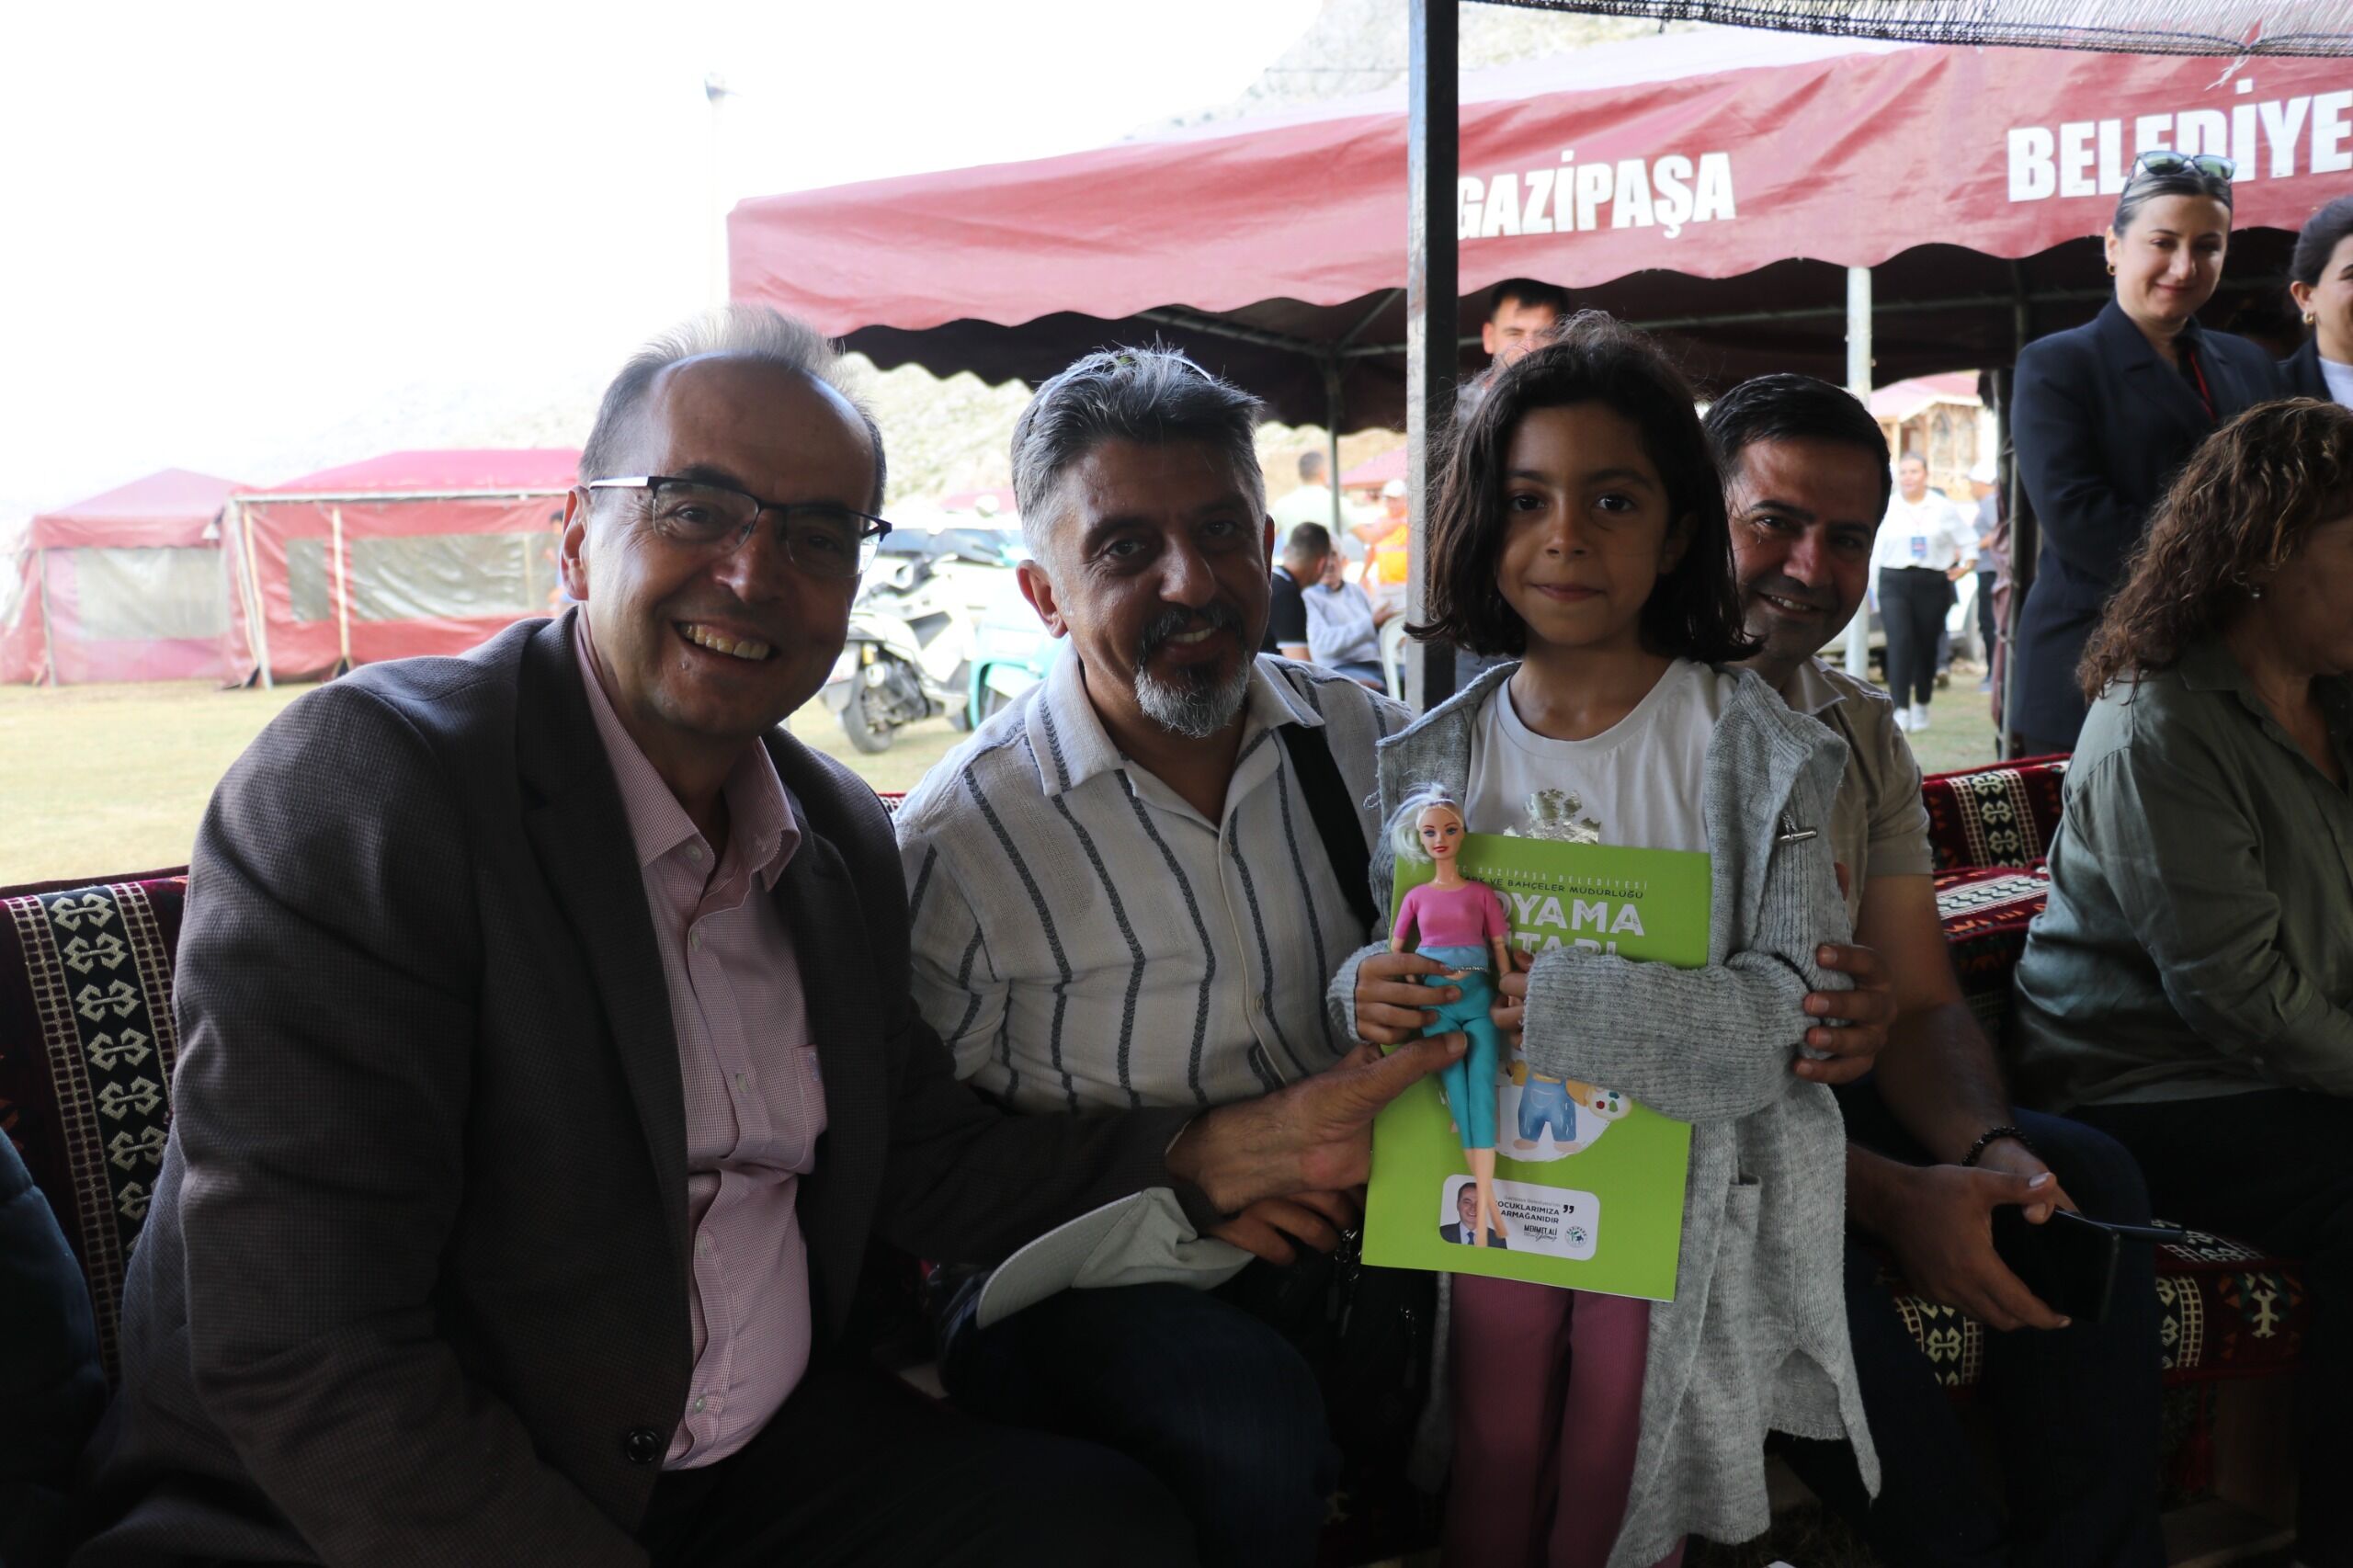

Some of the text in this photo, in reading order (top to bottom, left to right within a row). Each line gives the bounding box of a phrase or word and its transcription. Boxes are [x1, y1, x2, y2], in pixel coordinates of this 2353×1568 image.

[1458, 150, 1736, 240] GAZİPAŞA
[1507, 880, 1565, 892] BAHÇELER
[1495, 1200, 1560, 1215] OCUKLARIMIZA
[1501, 1210, 1560, 1224] ARMAĞANIDIR
[1524, 1224, 1548, 1234] MEHMET
